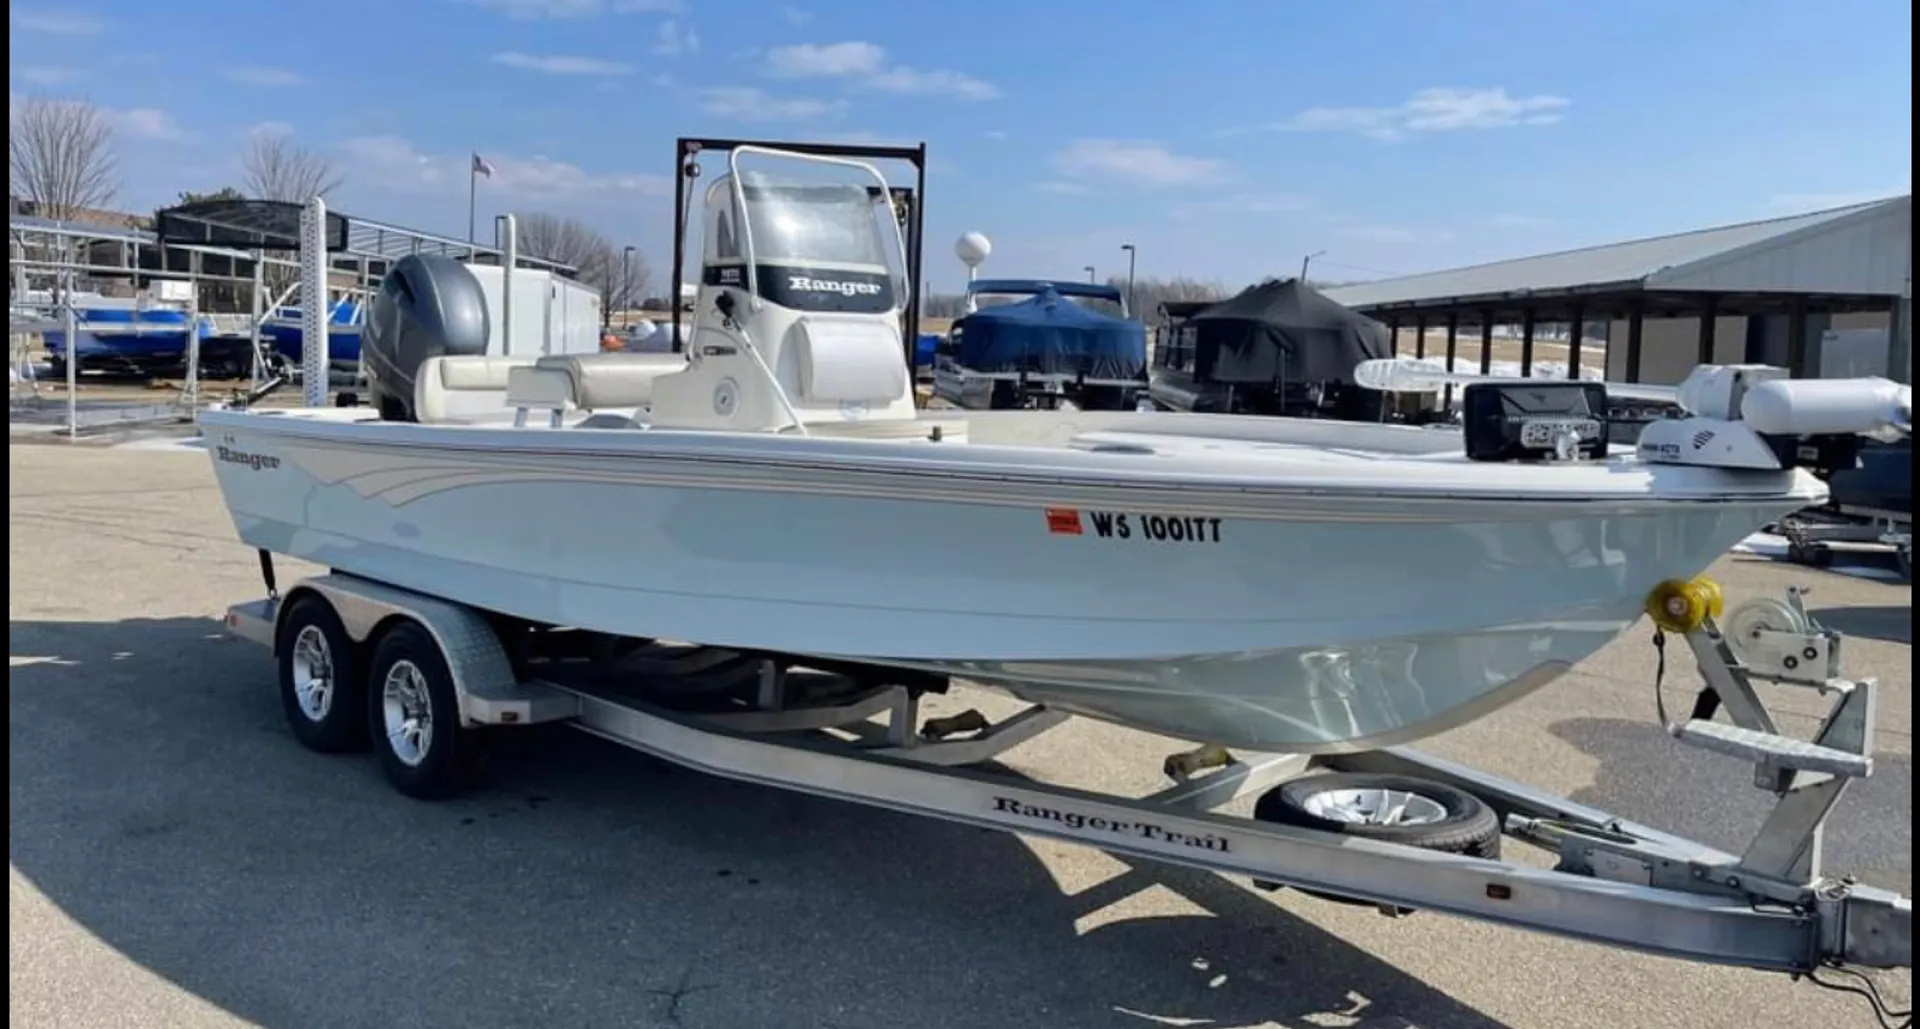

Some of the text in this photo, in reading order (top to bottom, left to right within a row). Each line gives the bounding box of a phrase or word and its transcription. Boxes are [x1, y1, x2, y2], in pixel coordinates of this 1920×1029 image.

[788, 276, 882, 295] Ranger
[216, 445, 280, 471] Ranger
[1091, 511, 1131, 539] WS
